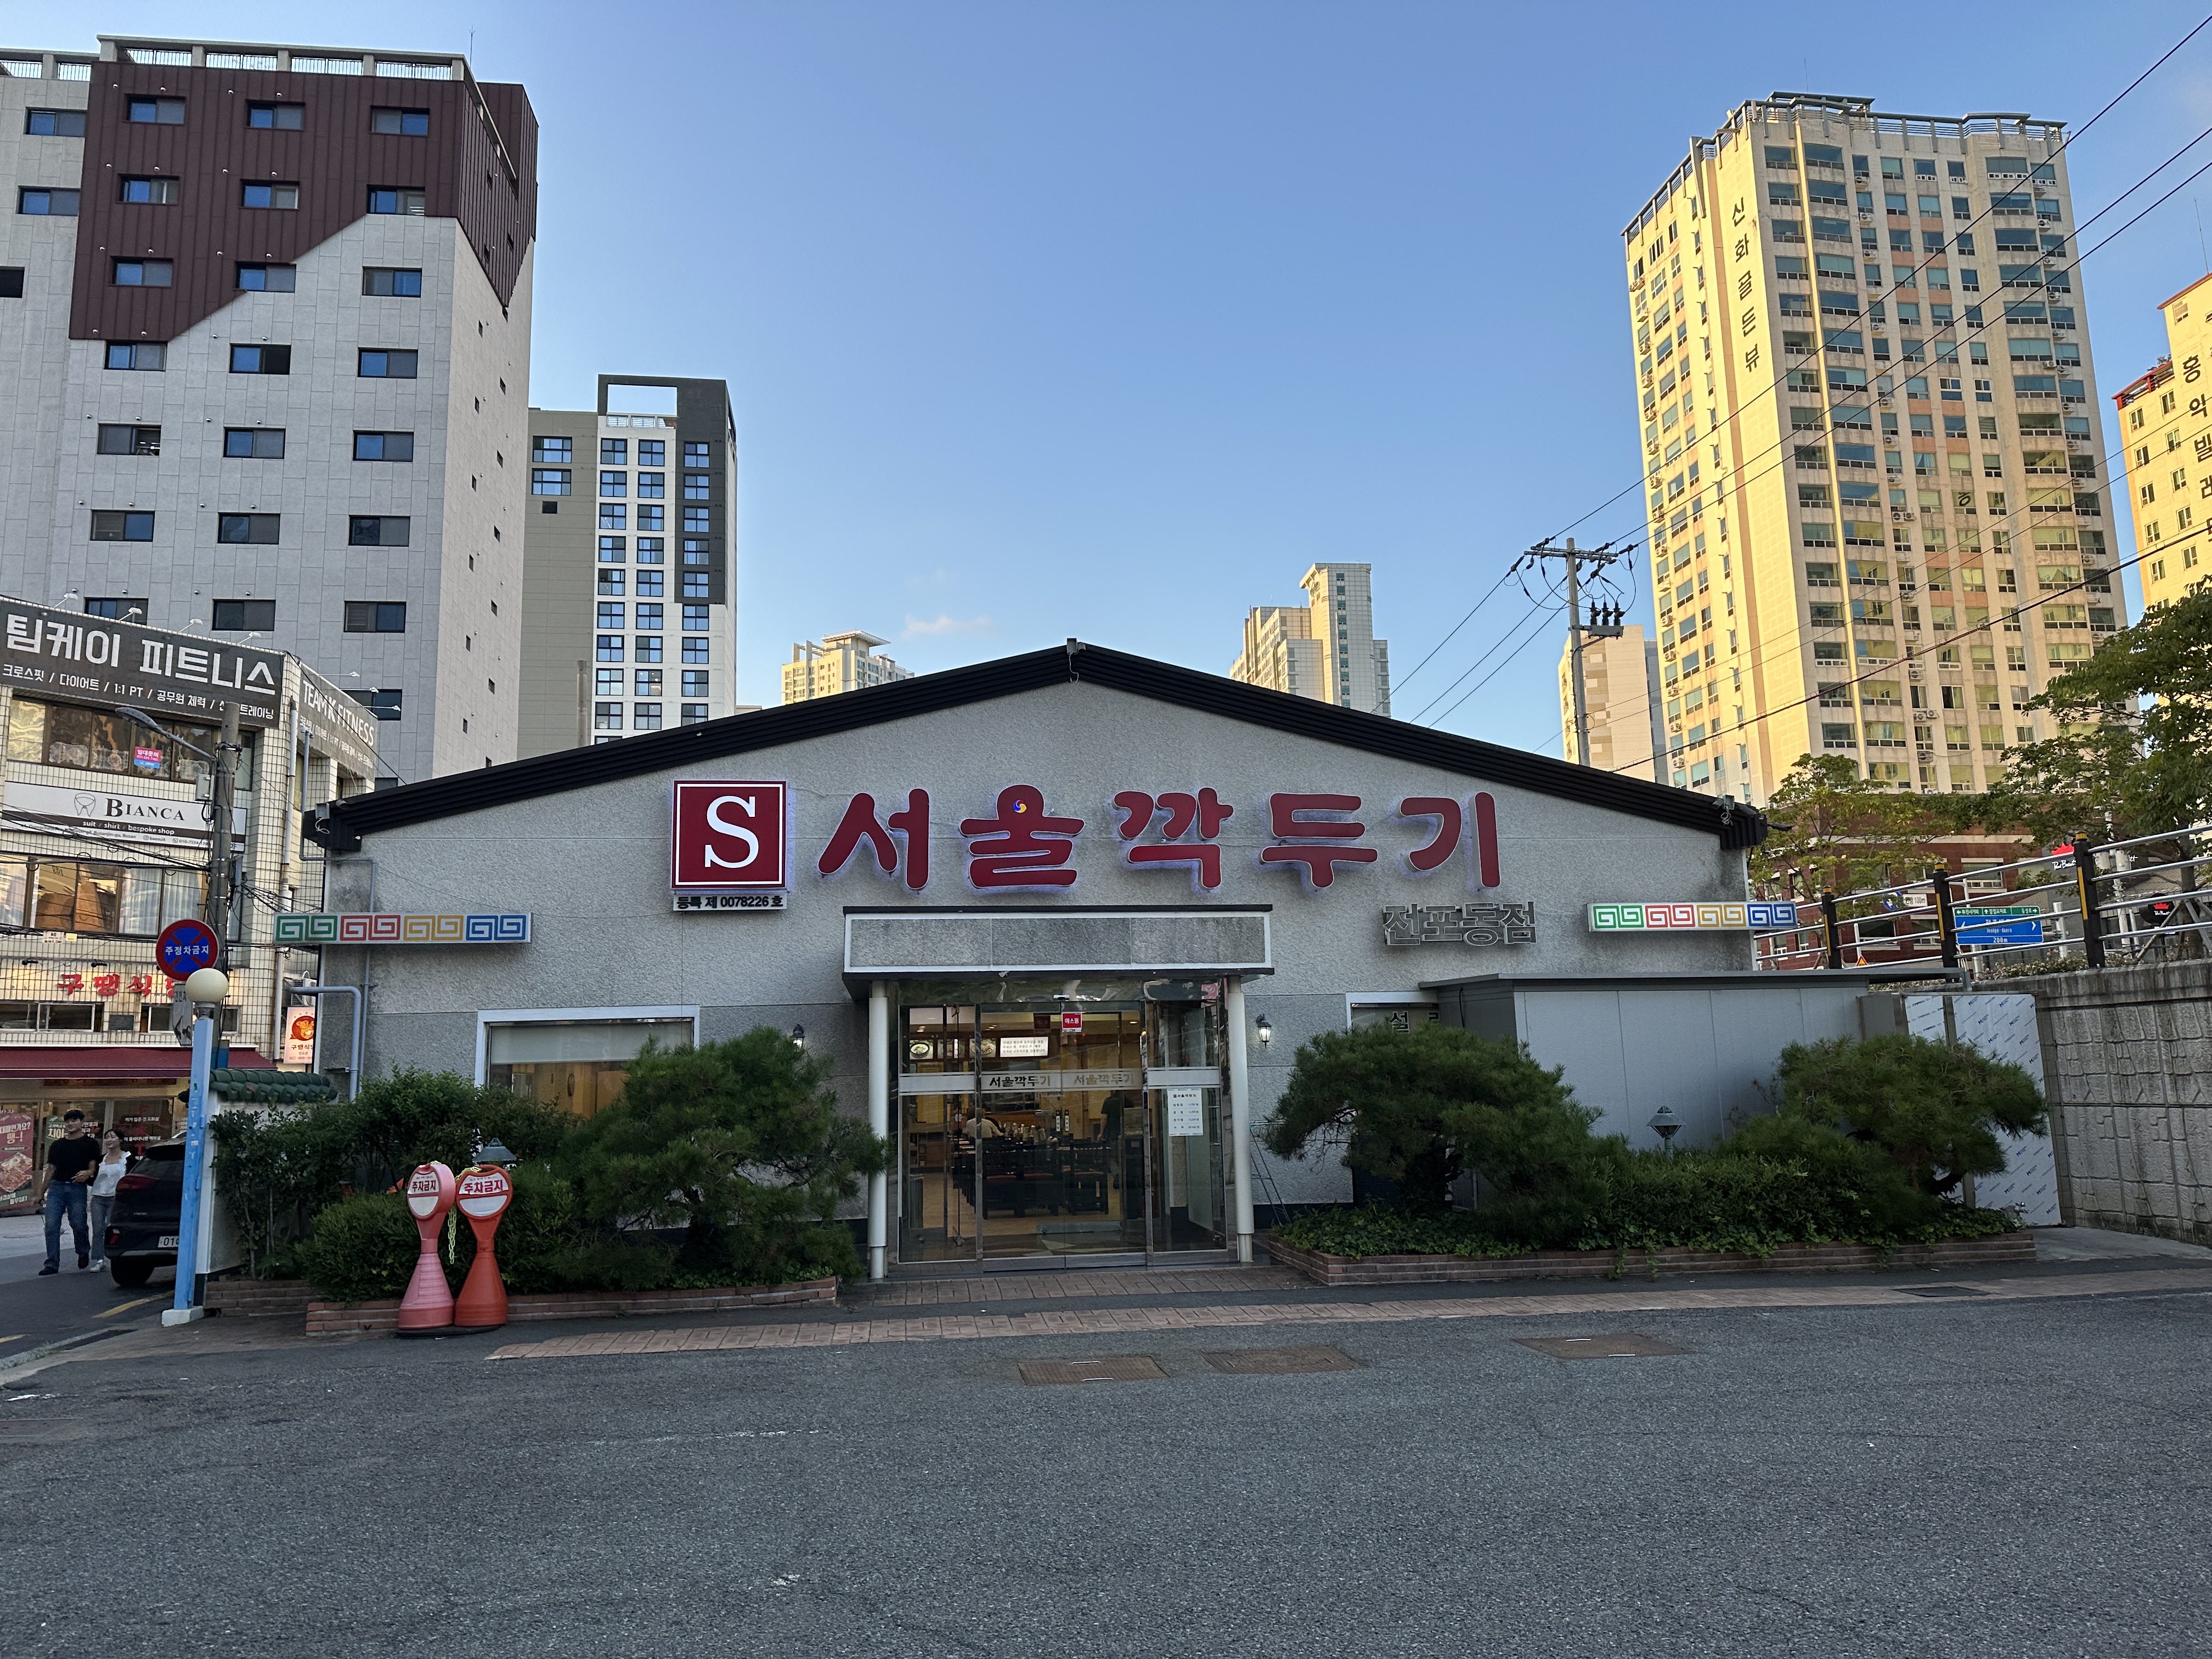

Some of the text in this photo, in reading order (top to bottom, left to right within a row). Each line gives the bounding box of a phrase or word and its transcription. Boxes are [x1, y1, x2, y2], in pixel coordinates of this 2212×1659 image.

[1732, 196, 1760, 373] 신화골든뷰
[7, 614, 275, 695] 팀케이 피트니스
[2, 664, 44, 681] 크로스핏
[59, 674, 99, 691] 다이어트
[114, 683, 125, 695] 1:1
[129, 686, 143, 697] PT
[157, 690, 184, 704] 공무원
[188, 695, 206, 708] 체력
[303, 680, 374, 746] TEAM K FITNESS
[105, 798, 185, 821] BIANCA
[128, 825, 157, 834] bespoke
[704, 795, 759, 868] S
[817, 784, 1502, 890] 서울깍두기
[677, 895, 783, 909] 등록 제 0078226 호
[1381, 901, 1537, 946] 전포동점
[165, 945, 209, 956] 주정차금지
[989, 1075, 1051, 1087] 서울깍두기
[1074, 1073, 1134, 1086] 서울깍두기
[412, 1180, 436, 1192] 주차금지
[464, 1180, 503, 1193] 주차금지
